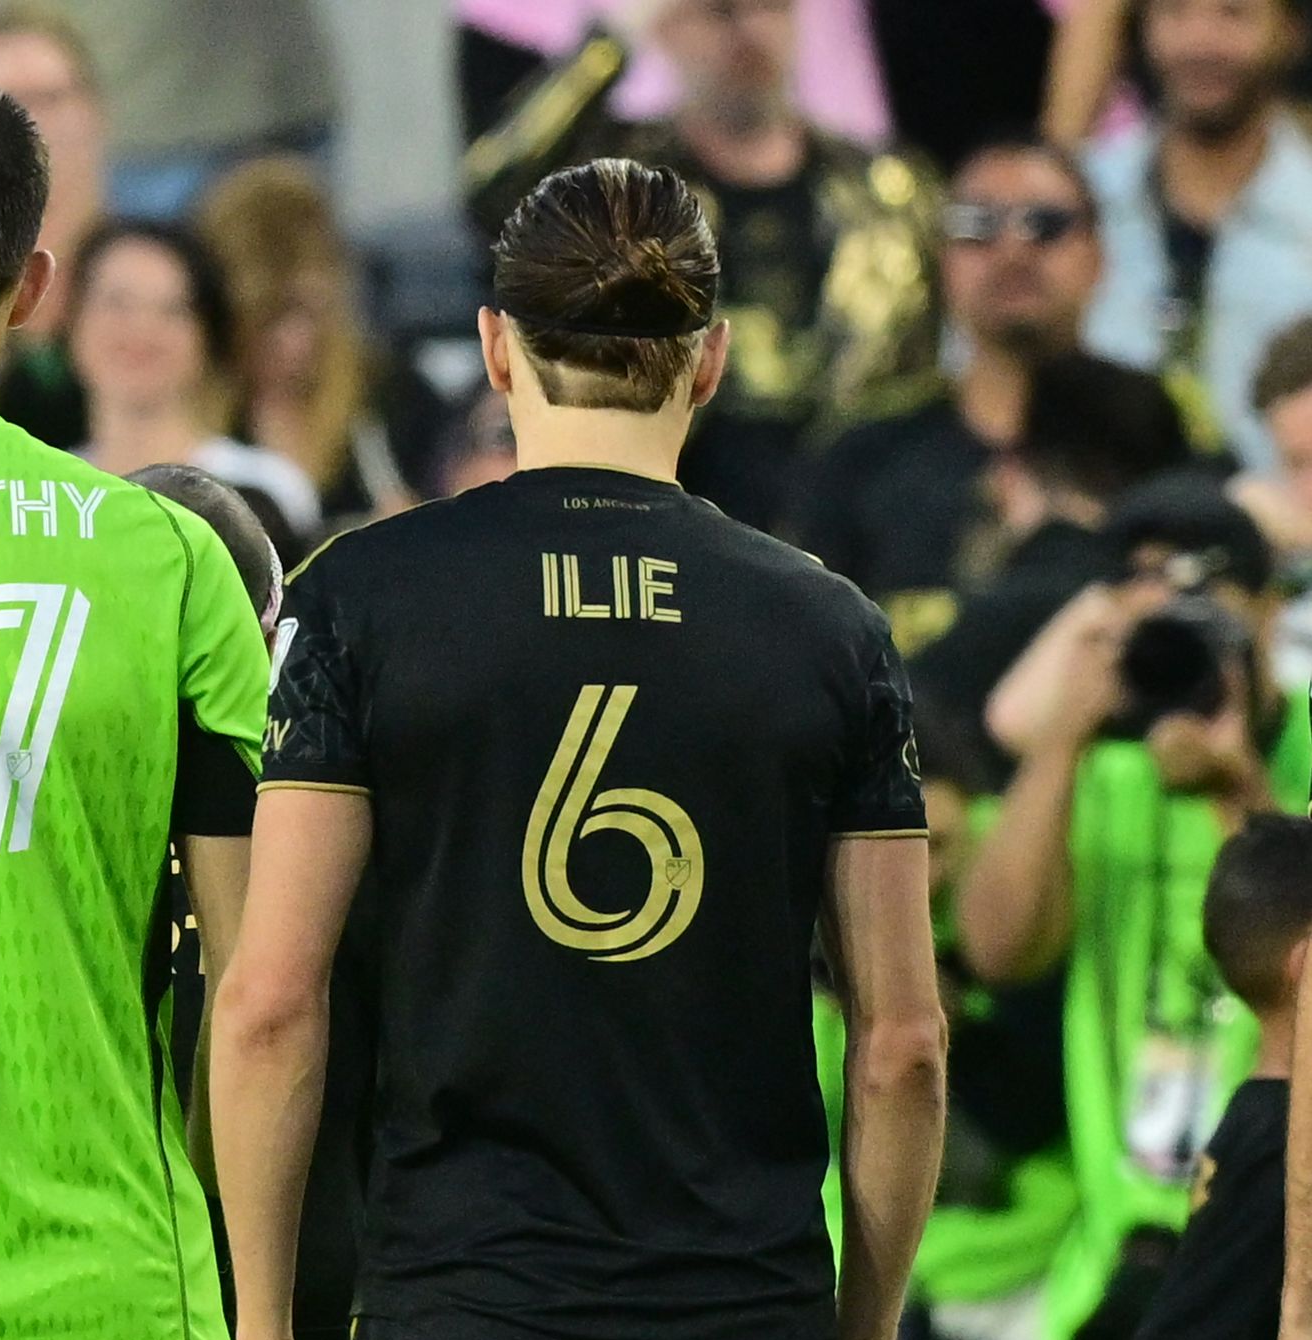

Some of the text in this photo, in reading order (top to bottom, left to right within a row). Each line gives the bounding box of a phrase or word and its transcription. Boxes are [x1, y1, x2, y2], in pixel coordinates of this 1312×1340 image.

[563, 497, 589, 511] LOS
[542, 552, 682, 623] ILIE
[522, 684, 705, 963] 6
